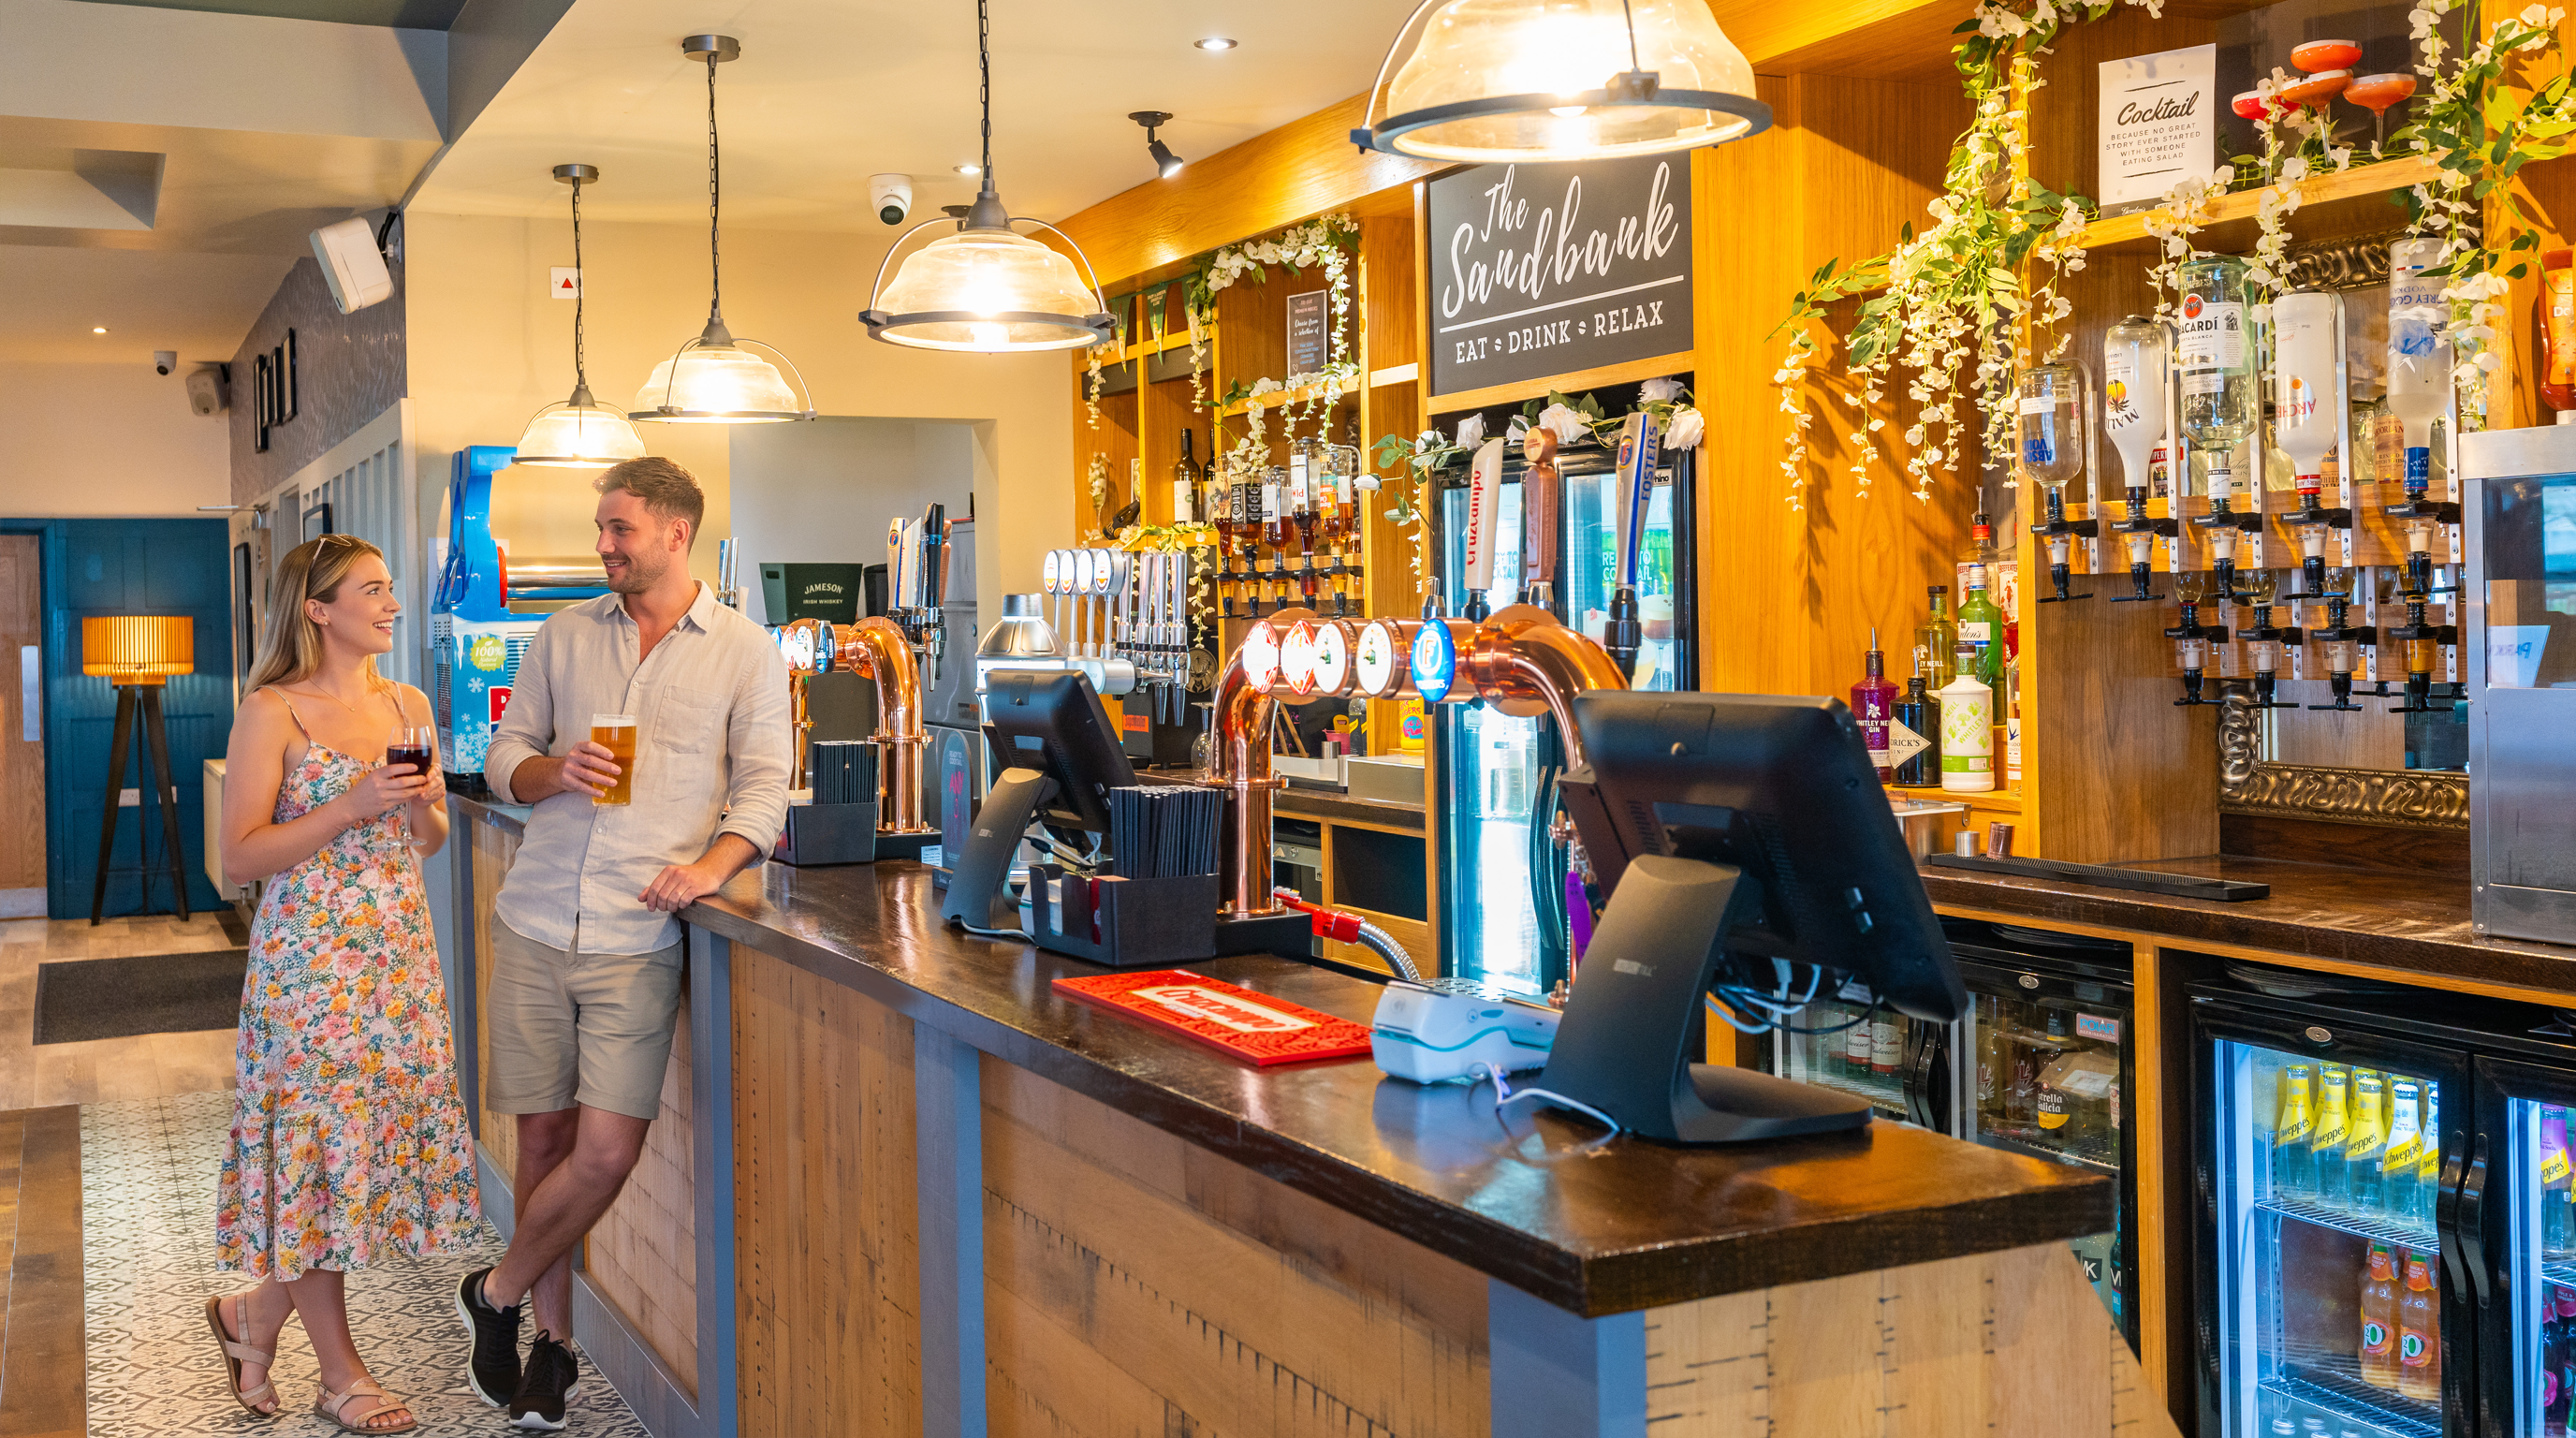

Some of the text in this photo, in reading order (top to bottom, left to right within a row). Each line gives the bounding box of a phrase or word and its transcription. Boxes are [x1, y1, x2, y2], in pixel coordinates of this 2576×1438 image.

[2117, 90, 2200, 126] Cocktail
[2111, 129, 2149, 141] BECAUSE
[2168, 123, 2197, 132] GREAT
[2105, 131, 2201, 151] STORY EVER STARTED
[2144, 142, 2187, 154] SOMEONE
[2122, 152, 2184, 167] EATING SALAD
[1481, 163, 1529, 242] The
[1442, 161, 1678, 318] Sandbank
[1295, 318, 1319, 328] Choose from
[1298, 328, 1313, 336] selection
[1456, 301, 1663, 364] EAT DRINK RELAX
[1621, 444, 1631, 464] F
[1641, 426, 1658, 501] FOSTER'S
[1654, 472, 1669, 483] hino
[804, 582, 843, 594] JAMESON
[476, 646, 503, 657] 100%
[1957, 716, 1984, 744] WHITLEY
[2079, 1030, 2116, 1039] REFRIGERATION
[2080, 1018, 2115, 1034] POLAR
[2038, 1093, 2062, 1104] strella
[2383, 1140, 2422, 1167] Schweppes
